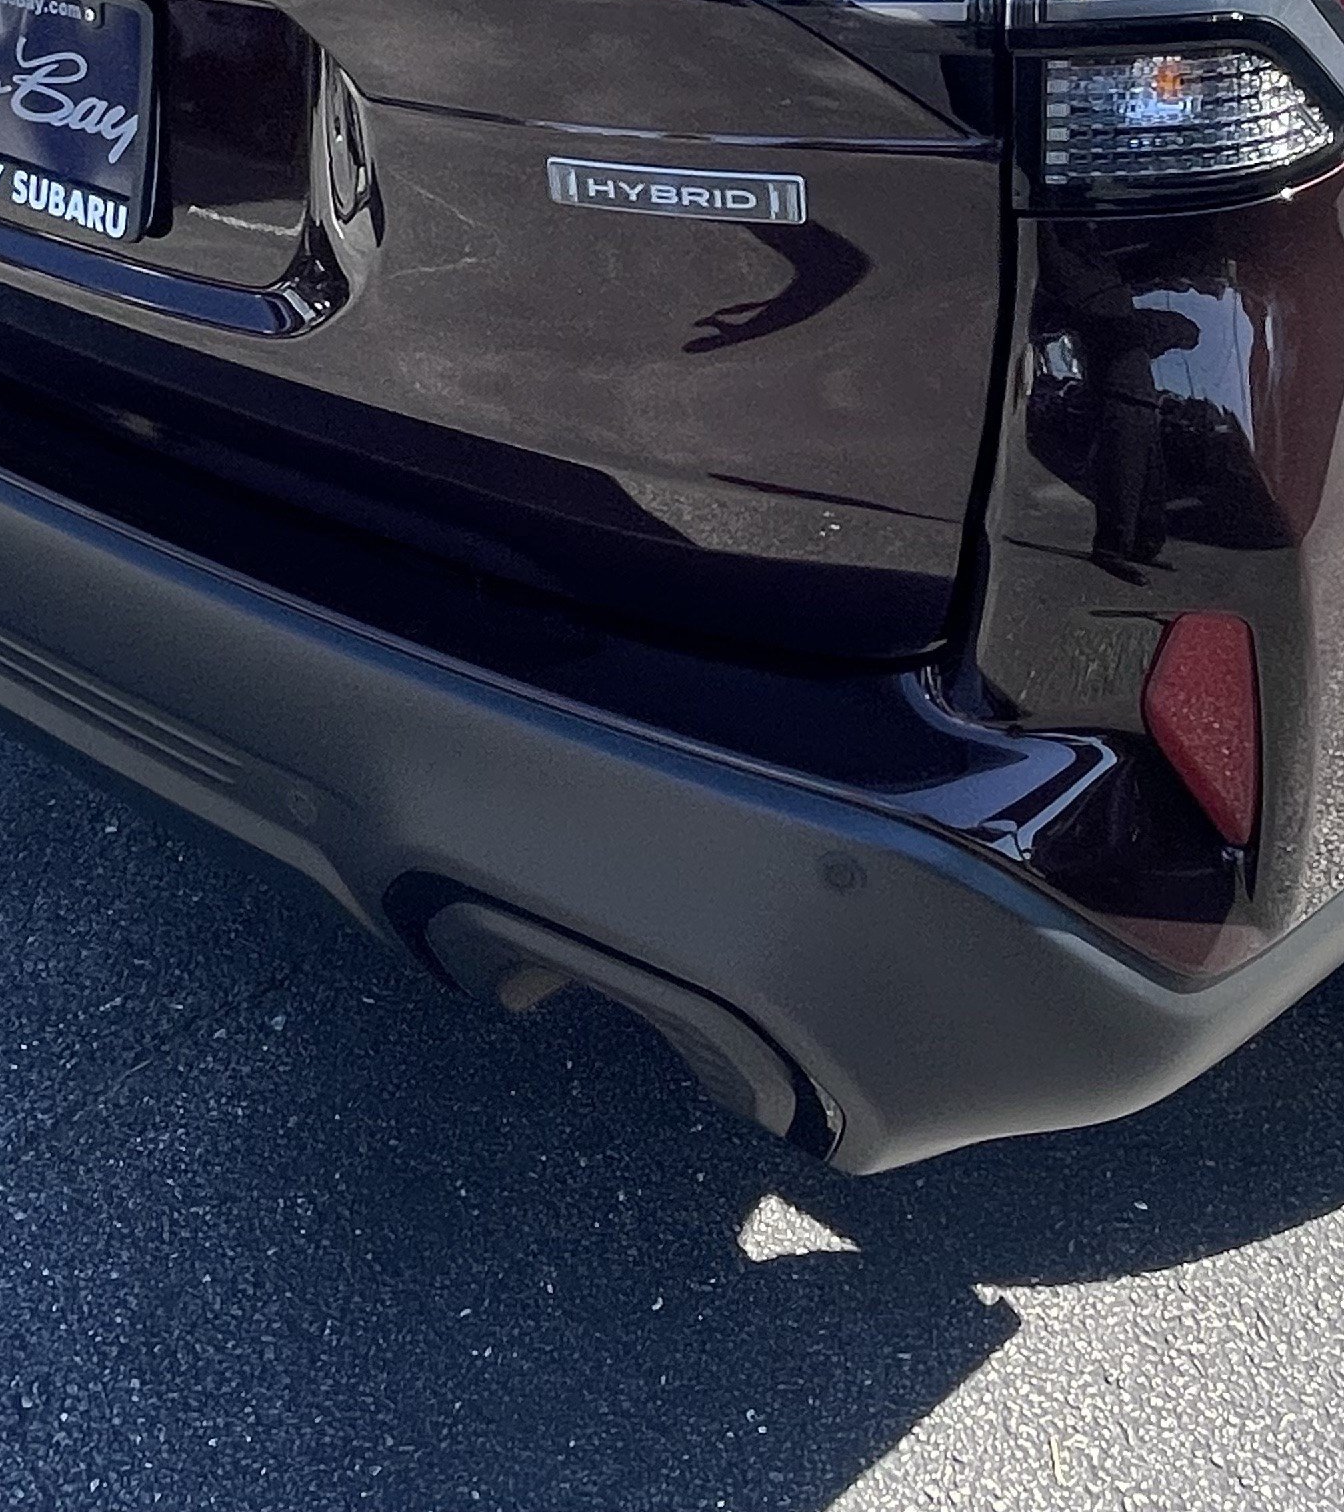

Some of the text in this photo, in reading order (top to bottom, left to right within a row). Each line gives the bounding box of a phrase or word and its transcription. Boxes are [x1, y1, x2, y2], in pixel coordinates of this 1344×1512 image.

[12, 37, 139, 164] Bay
[12, 170, 128, 239] SUBARU
[587, 177, 757, 210] HYBRID
